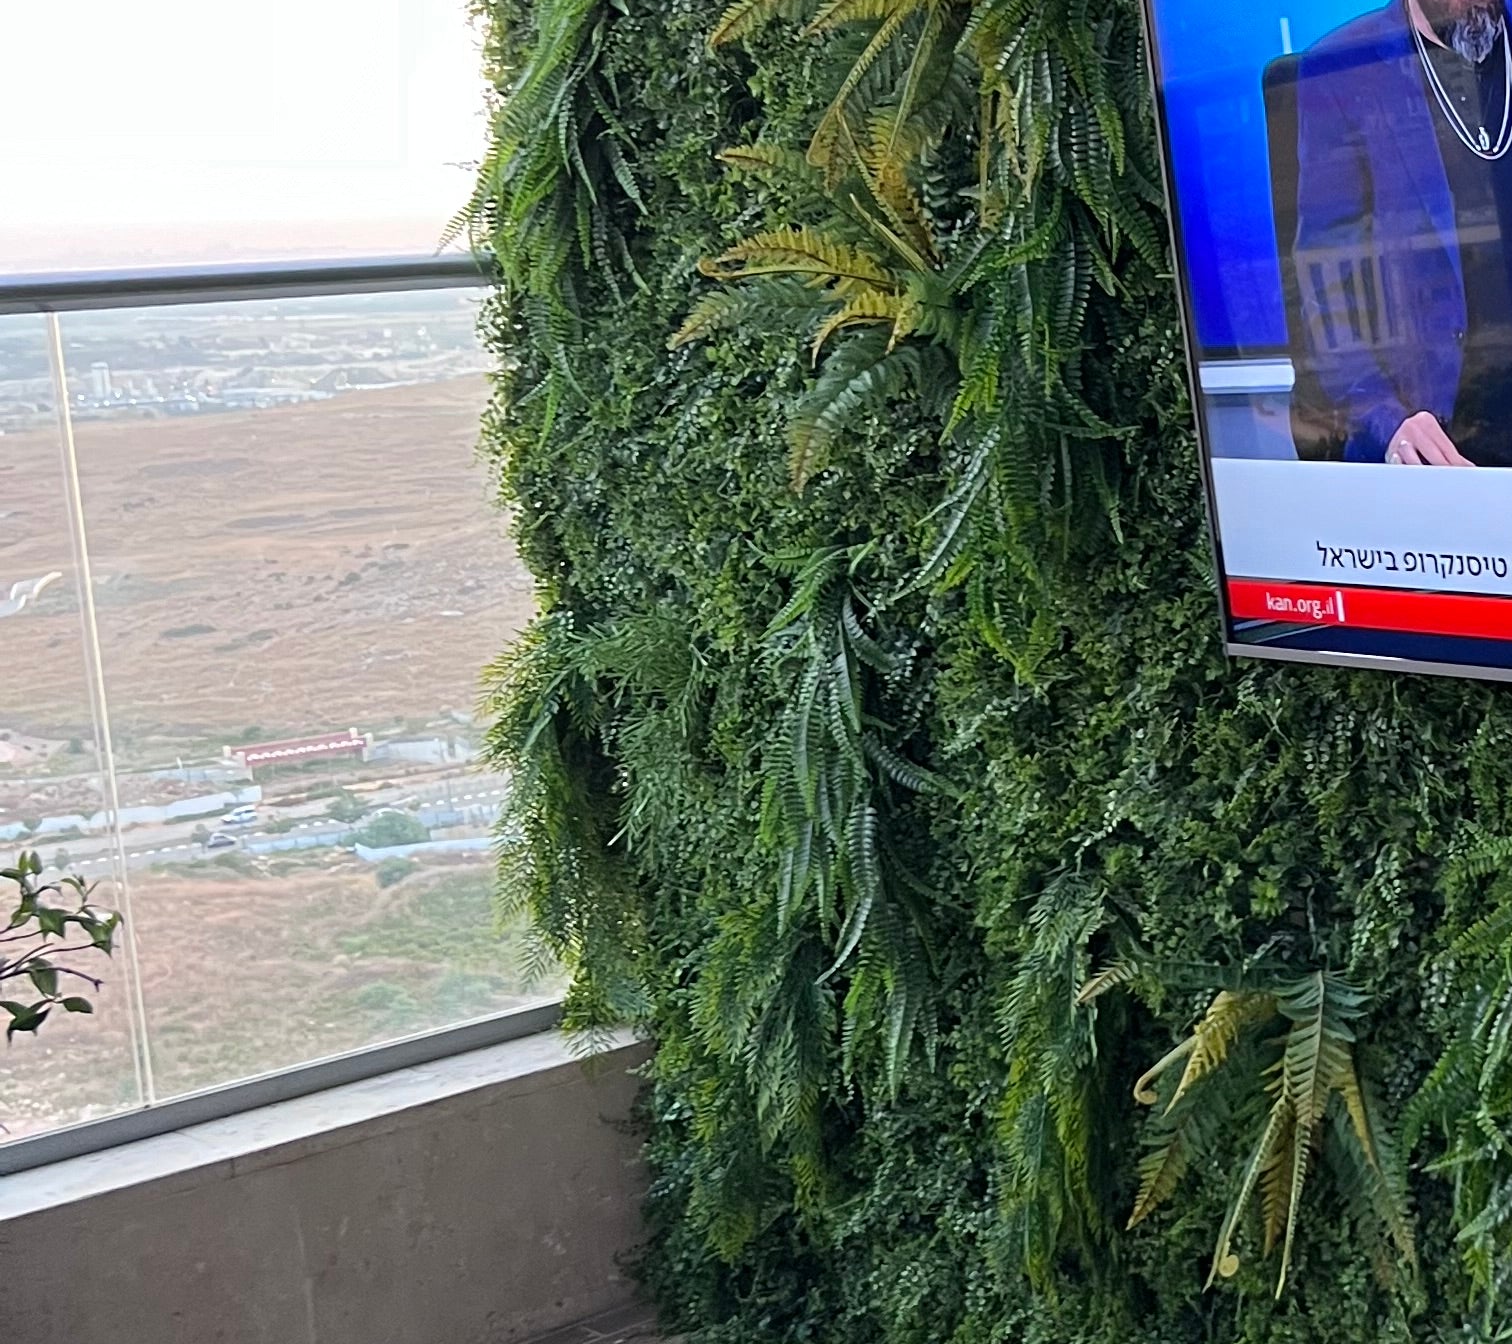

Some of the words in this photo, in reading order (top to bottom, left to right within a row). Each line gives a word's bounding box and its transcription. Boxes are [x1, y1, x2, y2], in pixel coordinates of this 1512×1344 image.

[1315, 540, 1399, 572] בישראל
[1402, 550, 1509, 580] טיסנקרופ
[1265, 591, 1335, 620] kan.org.il
